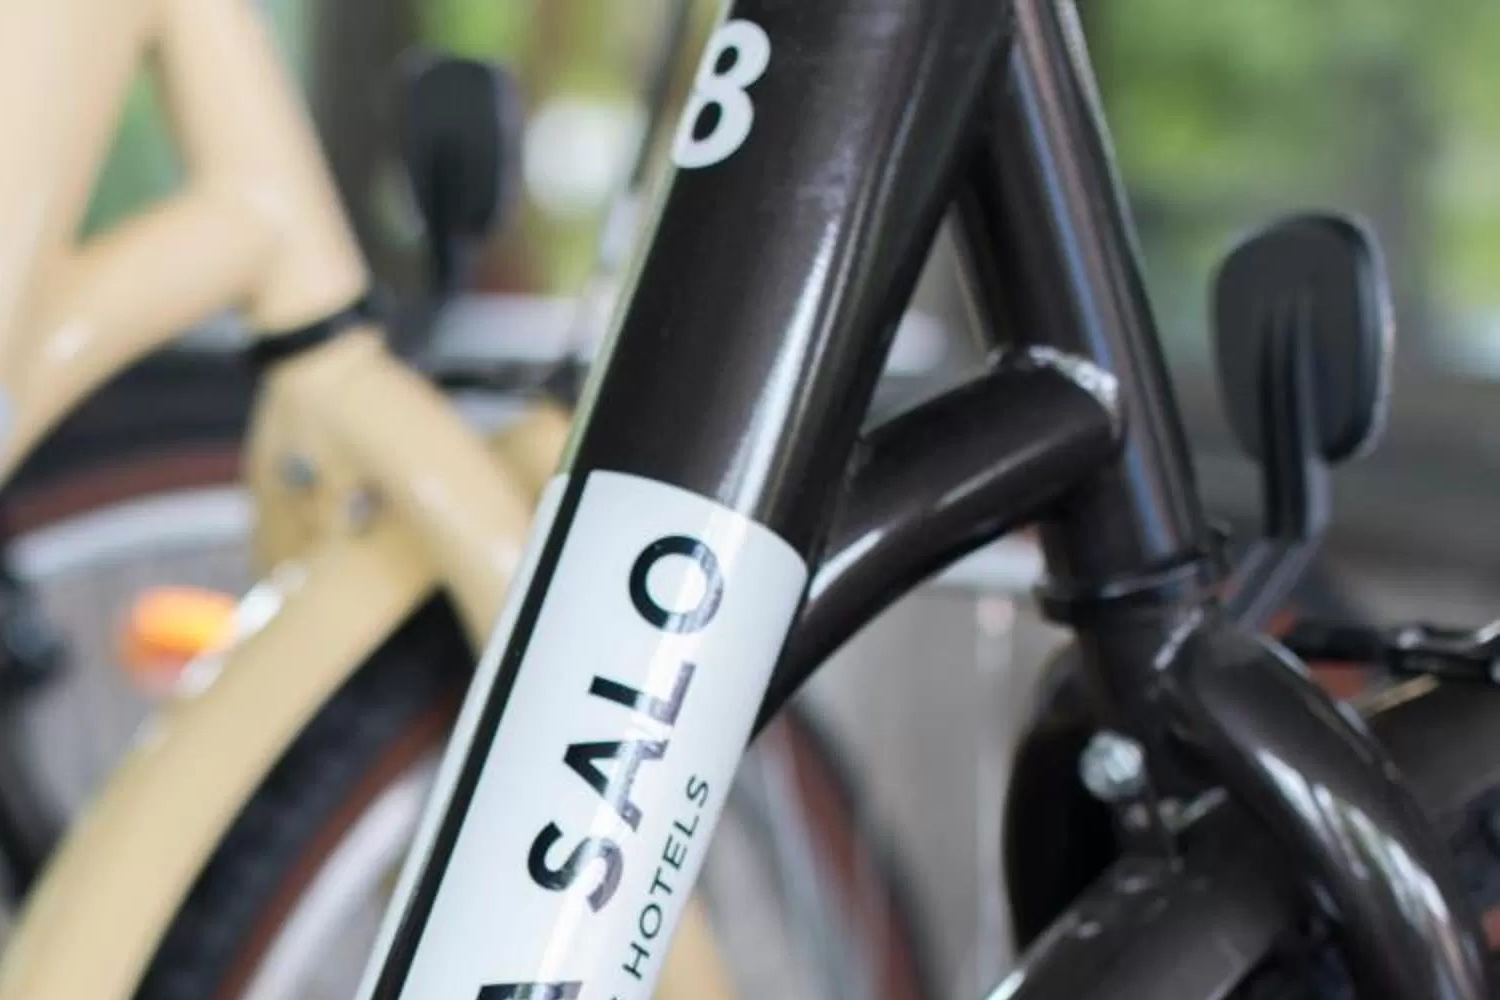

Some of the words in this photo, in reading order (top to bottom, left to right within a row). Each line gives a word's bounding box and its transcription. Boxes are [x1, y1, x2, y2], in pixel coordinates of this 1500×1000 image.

[671, 18, 771, 168] 8
[526, 534, 725, 913] SALO
[621, 776, 710, 981] HOTELS
